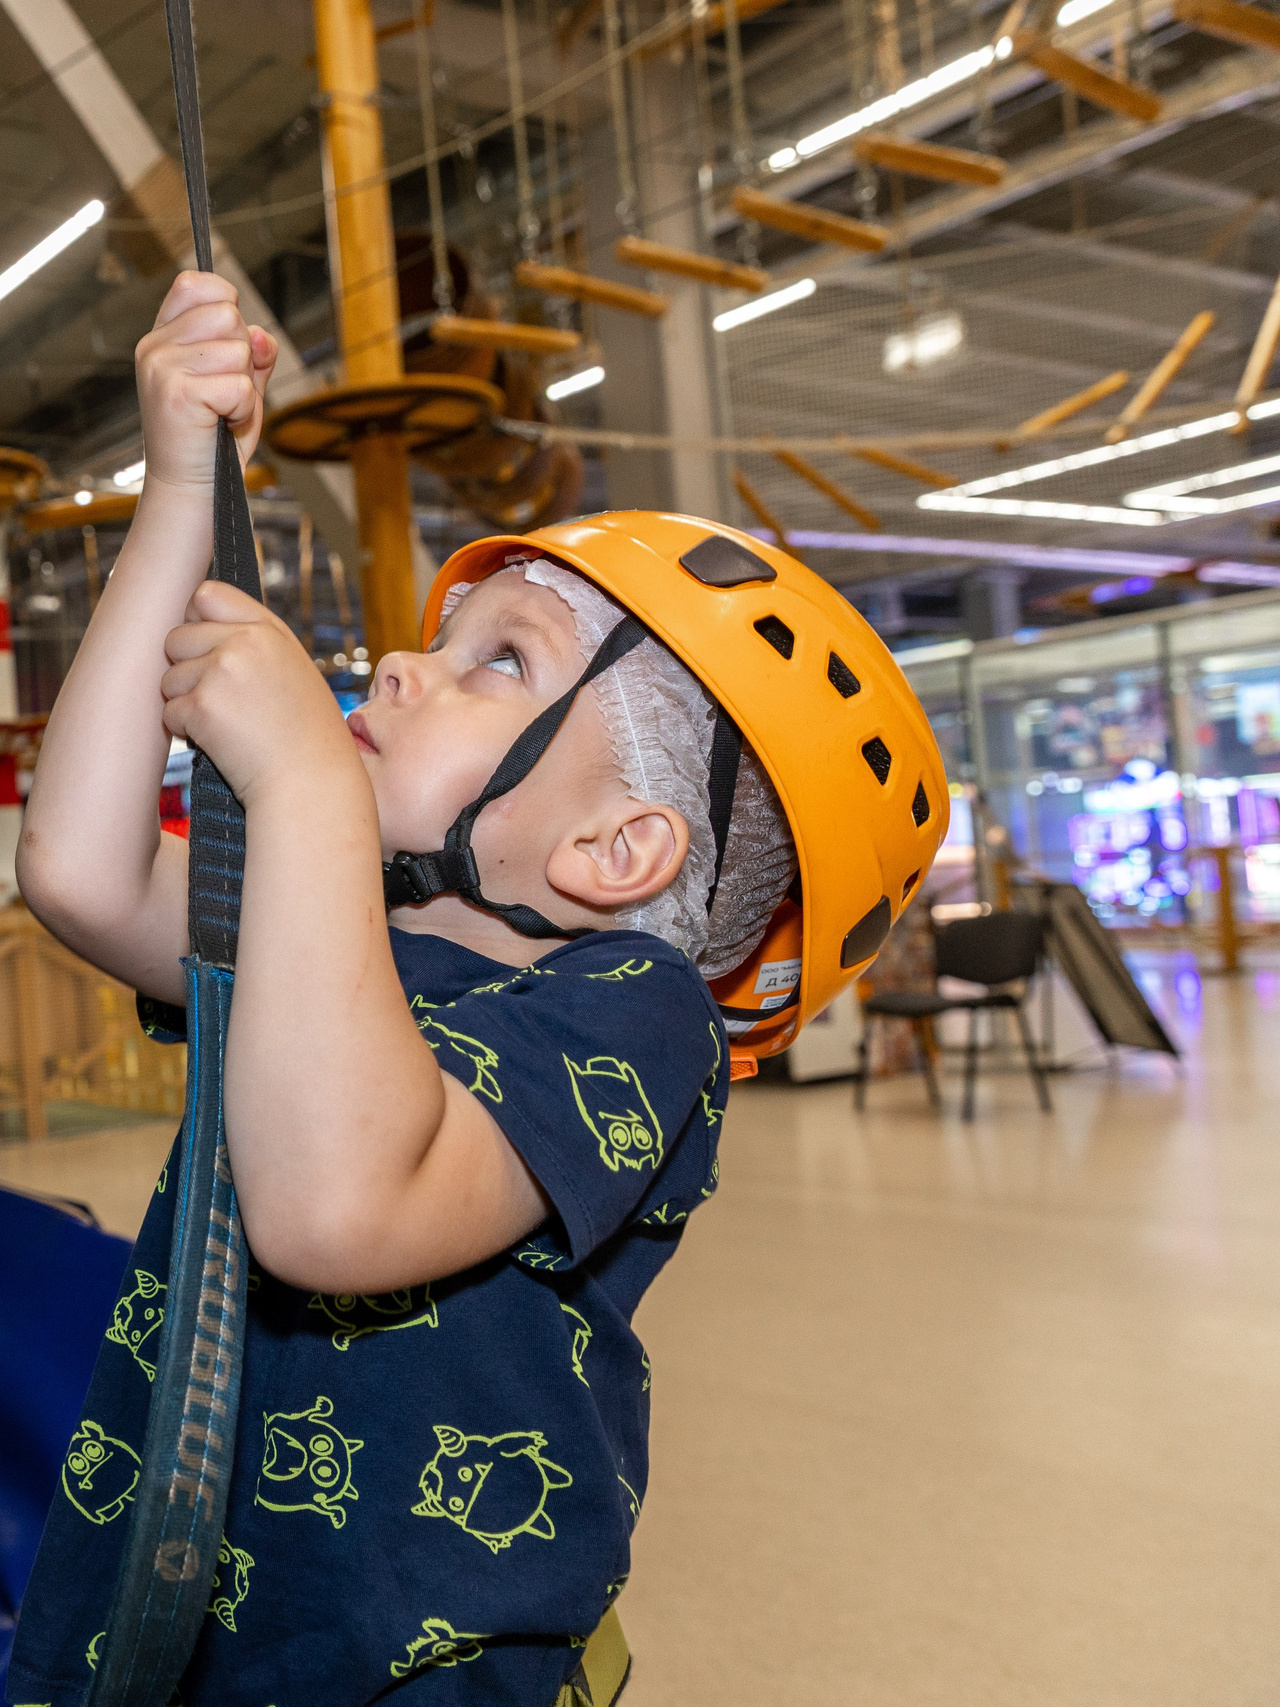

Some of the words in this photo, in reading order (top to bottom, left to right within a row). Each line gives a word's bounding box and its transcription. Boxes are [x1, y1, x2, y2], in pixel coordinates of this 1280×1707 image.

[765, 977, 778, 988] Д
[781, 973, 799, 983] 40
[168, 1206, 242, 1523] TRUBLUE
